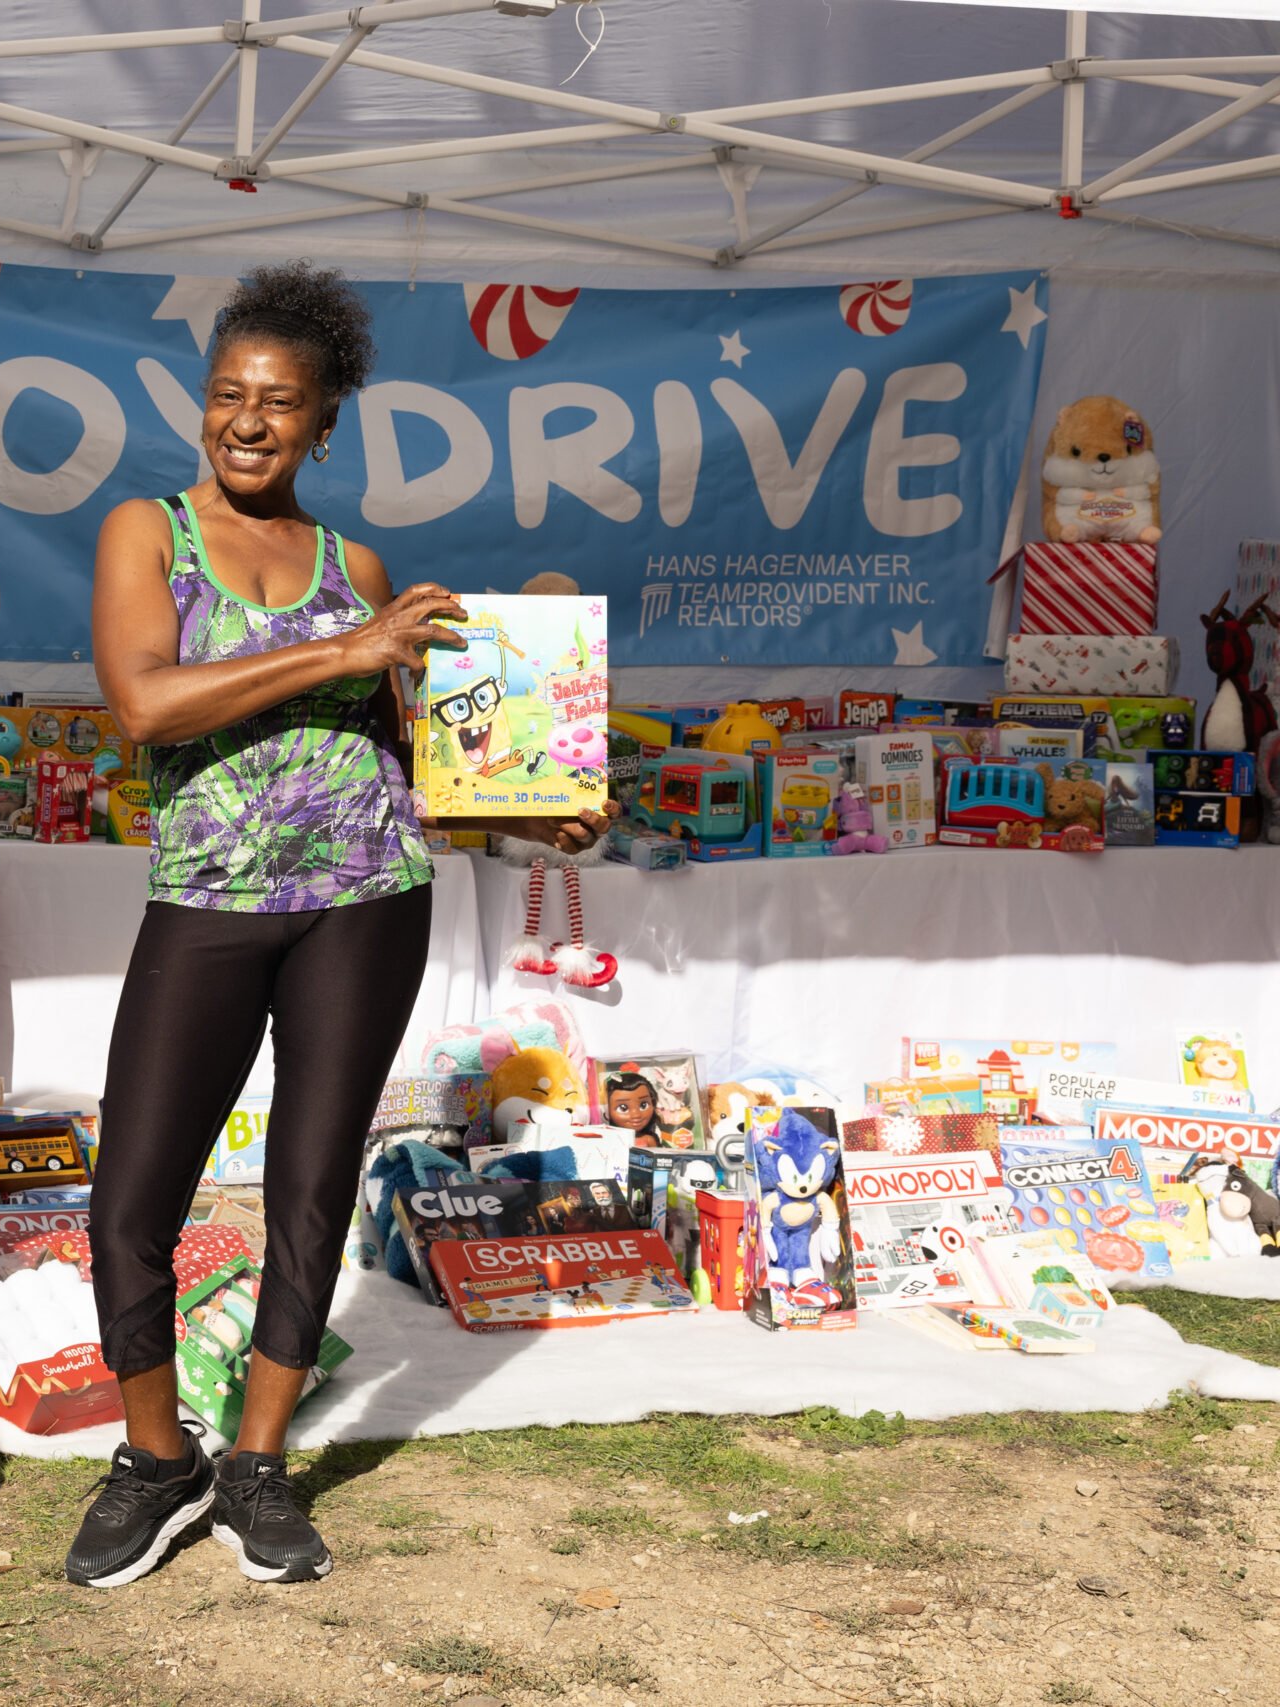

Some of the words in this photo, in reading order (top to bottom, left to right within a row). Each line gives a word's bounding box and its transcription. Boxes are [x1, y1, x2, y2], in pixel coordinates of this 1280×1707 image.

[361, 361, 967, 538] DRIVE
[646, 555, 716, 576] HANS
[724, 554, 911, 576] HAGENMAYER
[677, 583, 881, 604] TEAMPROVIDENT
[888, 582, 936, 604] INC.
[552, 674, 607, 701] Jellyfis
[843, 699, 889, 726] Jenga
[1000, 703, 1083, 716] SUPREME
[1093, 712, 1106, 723] 17
[888, 742, 915, 751] FAMILY
[1011, 747, 1066, 758] WHALES
[607, 755, 629, 768] OSS
[881, 749, 924, 765] DOMINOES
[578, 779, 597, 791] 500
[474, 791, 509, 804] Prime
[514, 791, 529, 803] 3D
[533, 791, 570, 804] Puzzle
[133, 814, 150, 827] 64
[124, 829, 150, 838] CRAYO
[413, 1079, 455, 1095] STUDIO
[1049, 1073, 1116, 1091] POPULAR
[1051, 1085, 1113, 1102] SCIENCE
[378, 1095, 410, 1113] TELIER
[412, 1095, 465, 1109] PEINTURE
[371, 1112, 410, 1130] STUDIO
[411, 1112, 422, 1122] DE
[1102, 1115, 1280, 1156] MONOPOLY
[1008, 1158, 1111, 1187] CONNECT
[1109, 1149, 1136, 1179] 4
[847, 1167, 976, 1199] MONOPOLY
[410, 1189, 503, 1219] Clue
[476, 1239, 641, 1268] SCRABBLE
[475, 1280, 510, 1290] GAME
[523, 1275, 537, 1283] ON
[902, 1280, 927, 1295] GO
[786, 1310, 822, 1319] SONIC
[61, 1344, 97, 1359] INDOOR
[41, 1354, 96, 1377] Snowball
